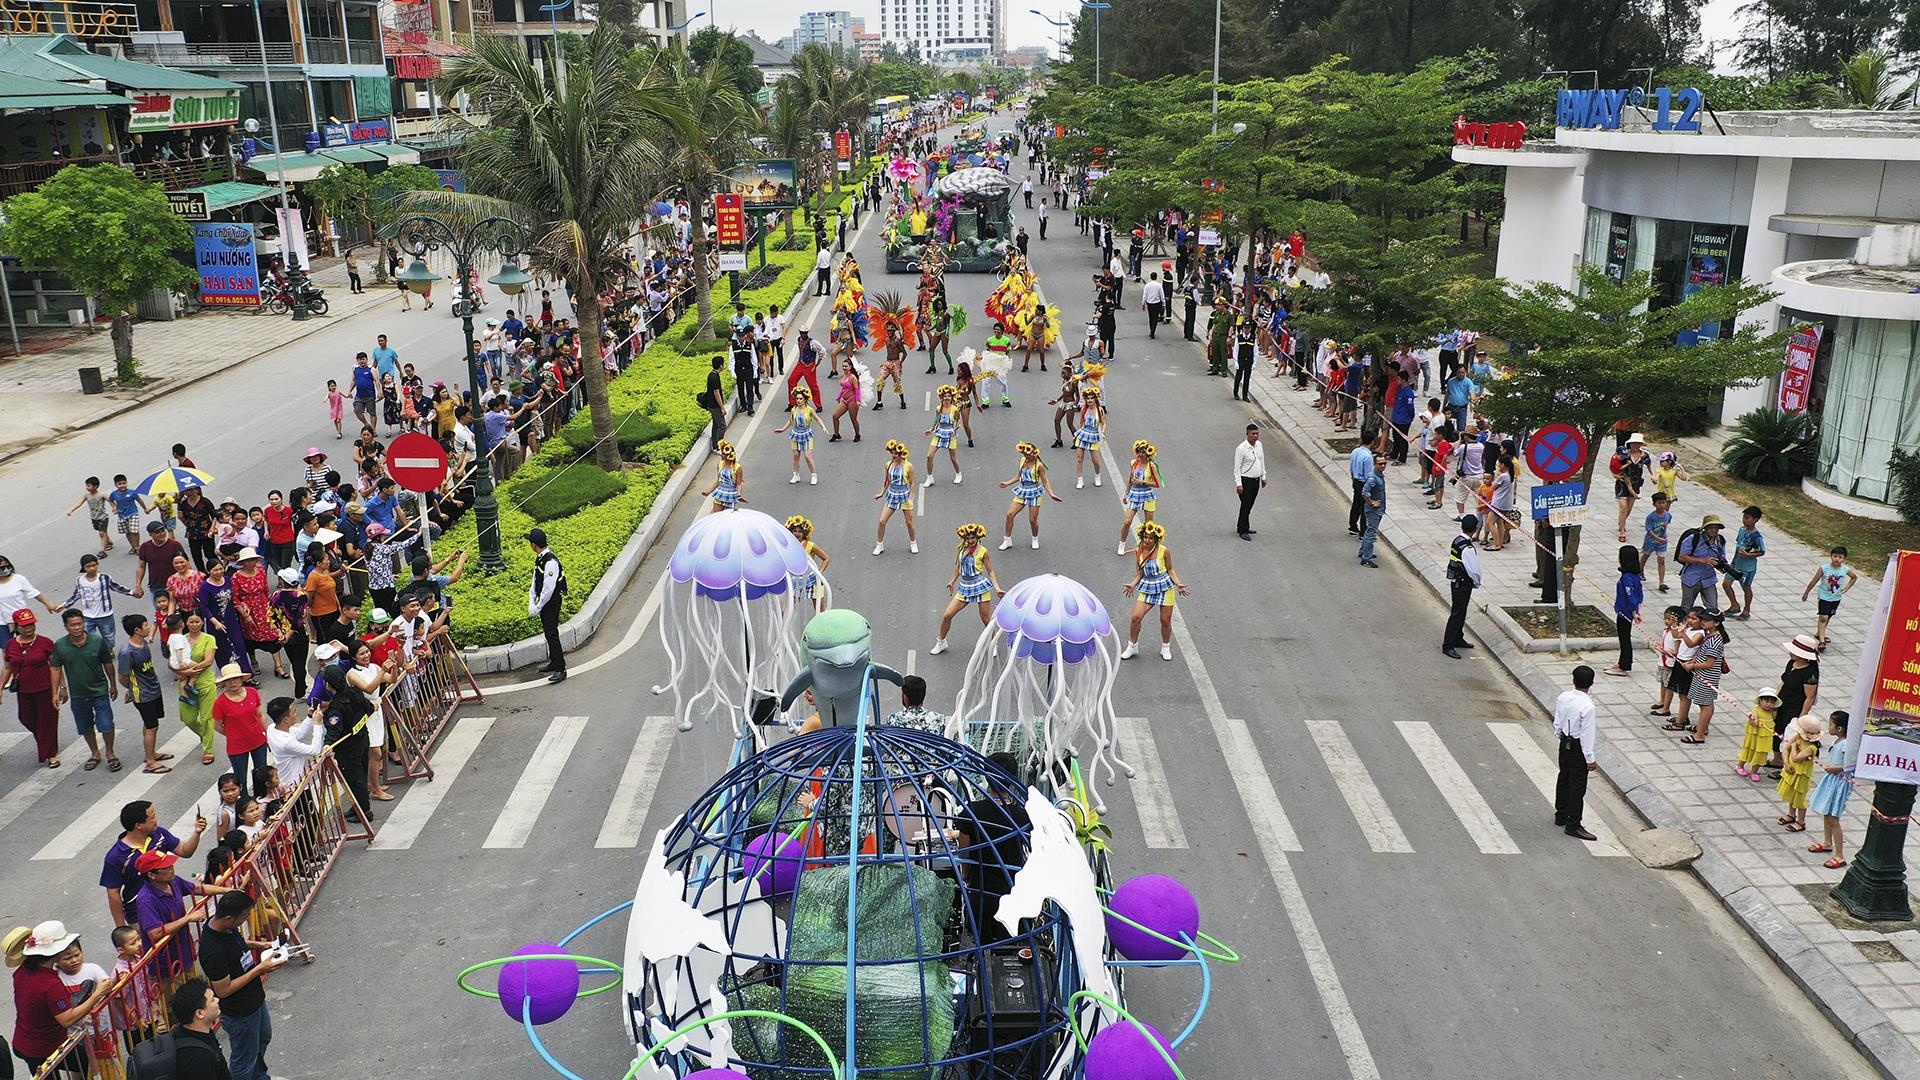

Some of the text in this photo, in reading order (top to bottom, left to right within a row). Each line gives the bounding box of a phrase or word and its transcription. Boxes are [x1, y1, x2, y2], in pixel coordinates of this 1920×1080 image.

[1652, 87, 1703, 132] 12
[169, 199, 204, 214] TUYẾT
[1691, 246, 1728, 257] CLUB BEER
[1533, 494, 1547, 510] CẤM
[1574, 494, 1582, 505] XE
[1882, 678, 1910, 693] TRONG
[1883, 696, 1901, 712] CỦA
[1864, 752, 1891, 767] BIA
